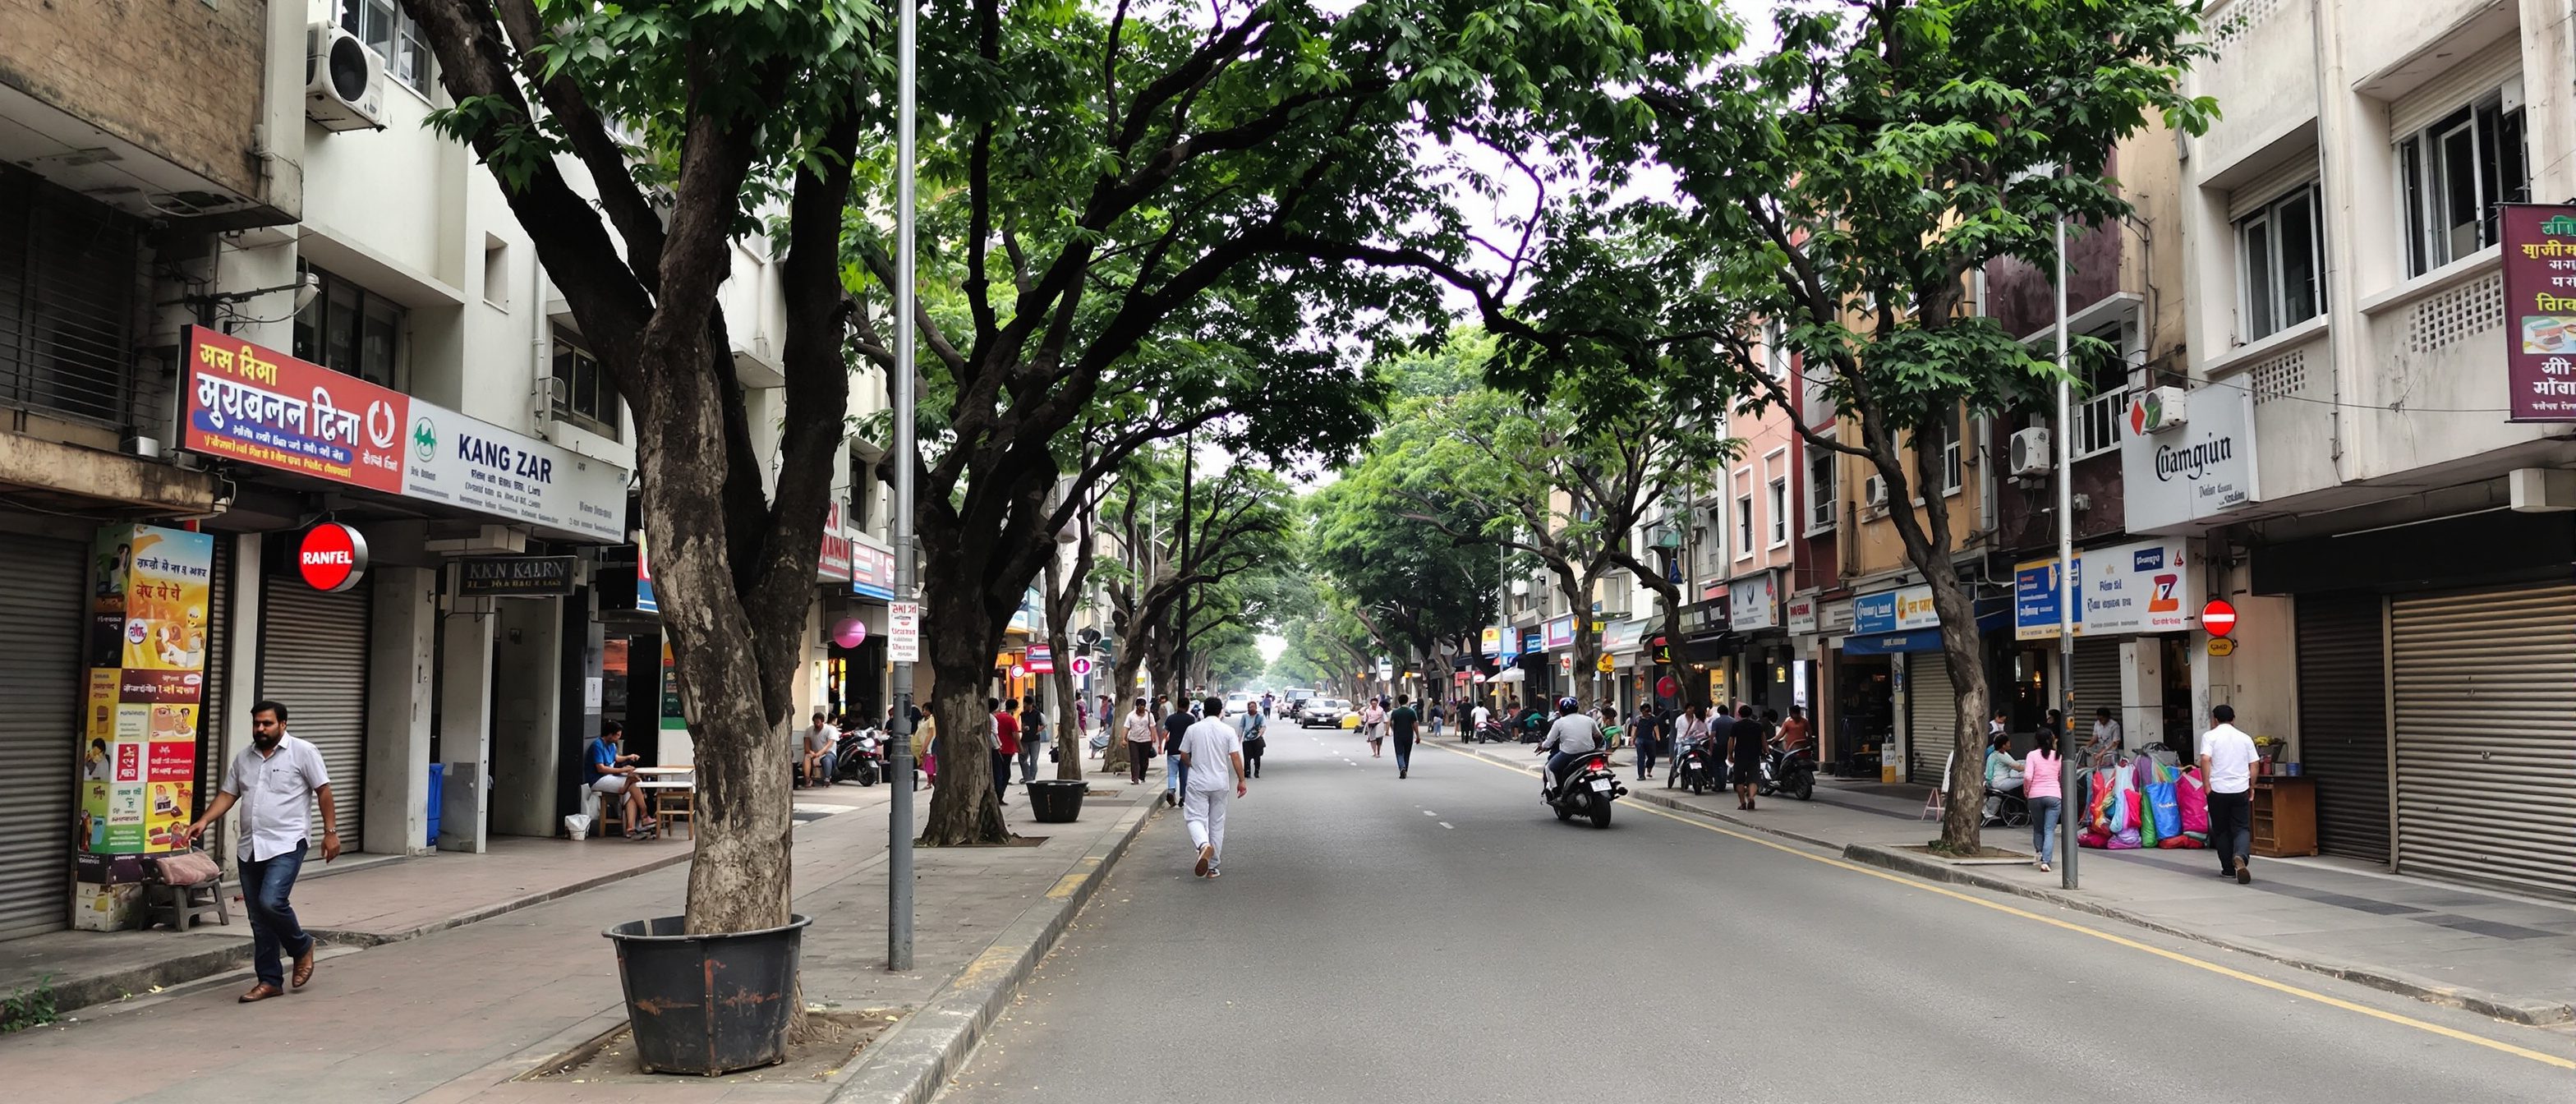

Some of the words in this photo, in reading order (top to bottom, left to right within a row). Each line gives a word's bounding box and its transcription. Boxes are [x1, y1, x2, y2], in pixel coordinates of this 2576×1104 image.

[458, 434, 510, 472] KANG
[517, 450, 552, 485] ZAR
[302, 550, 353, 565] RANFEL
